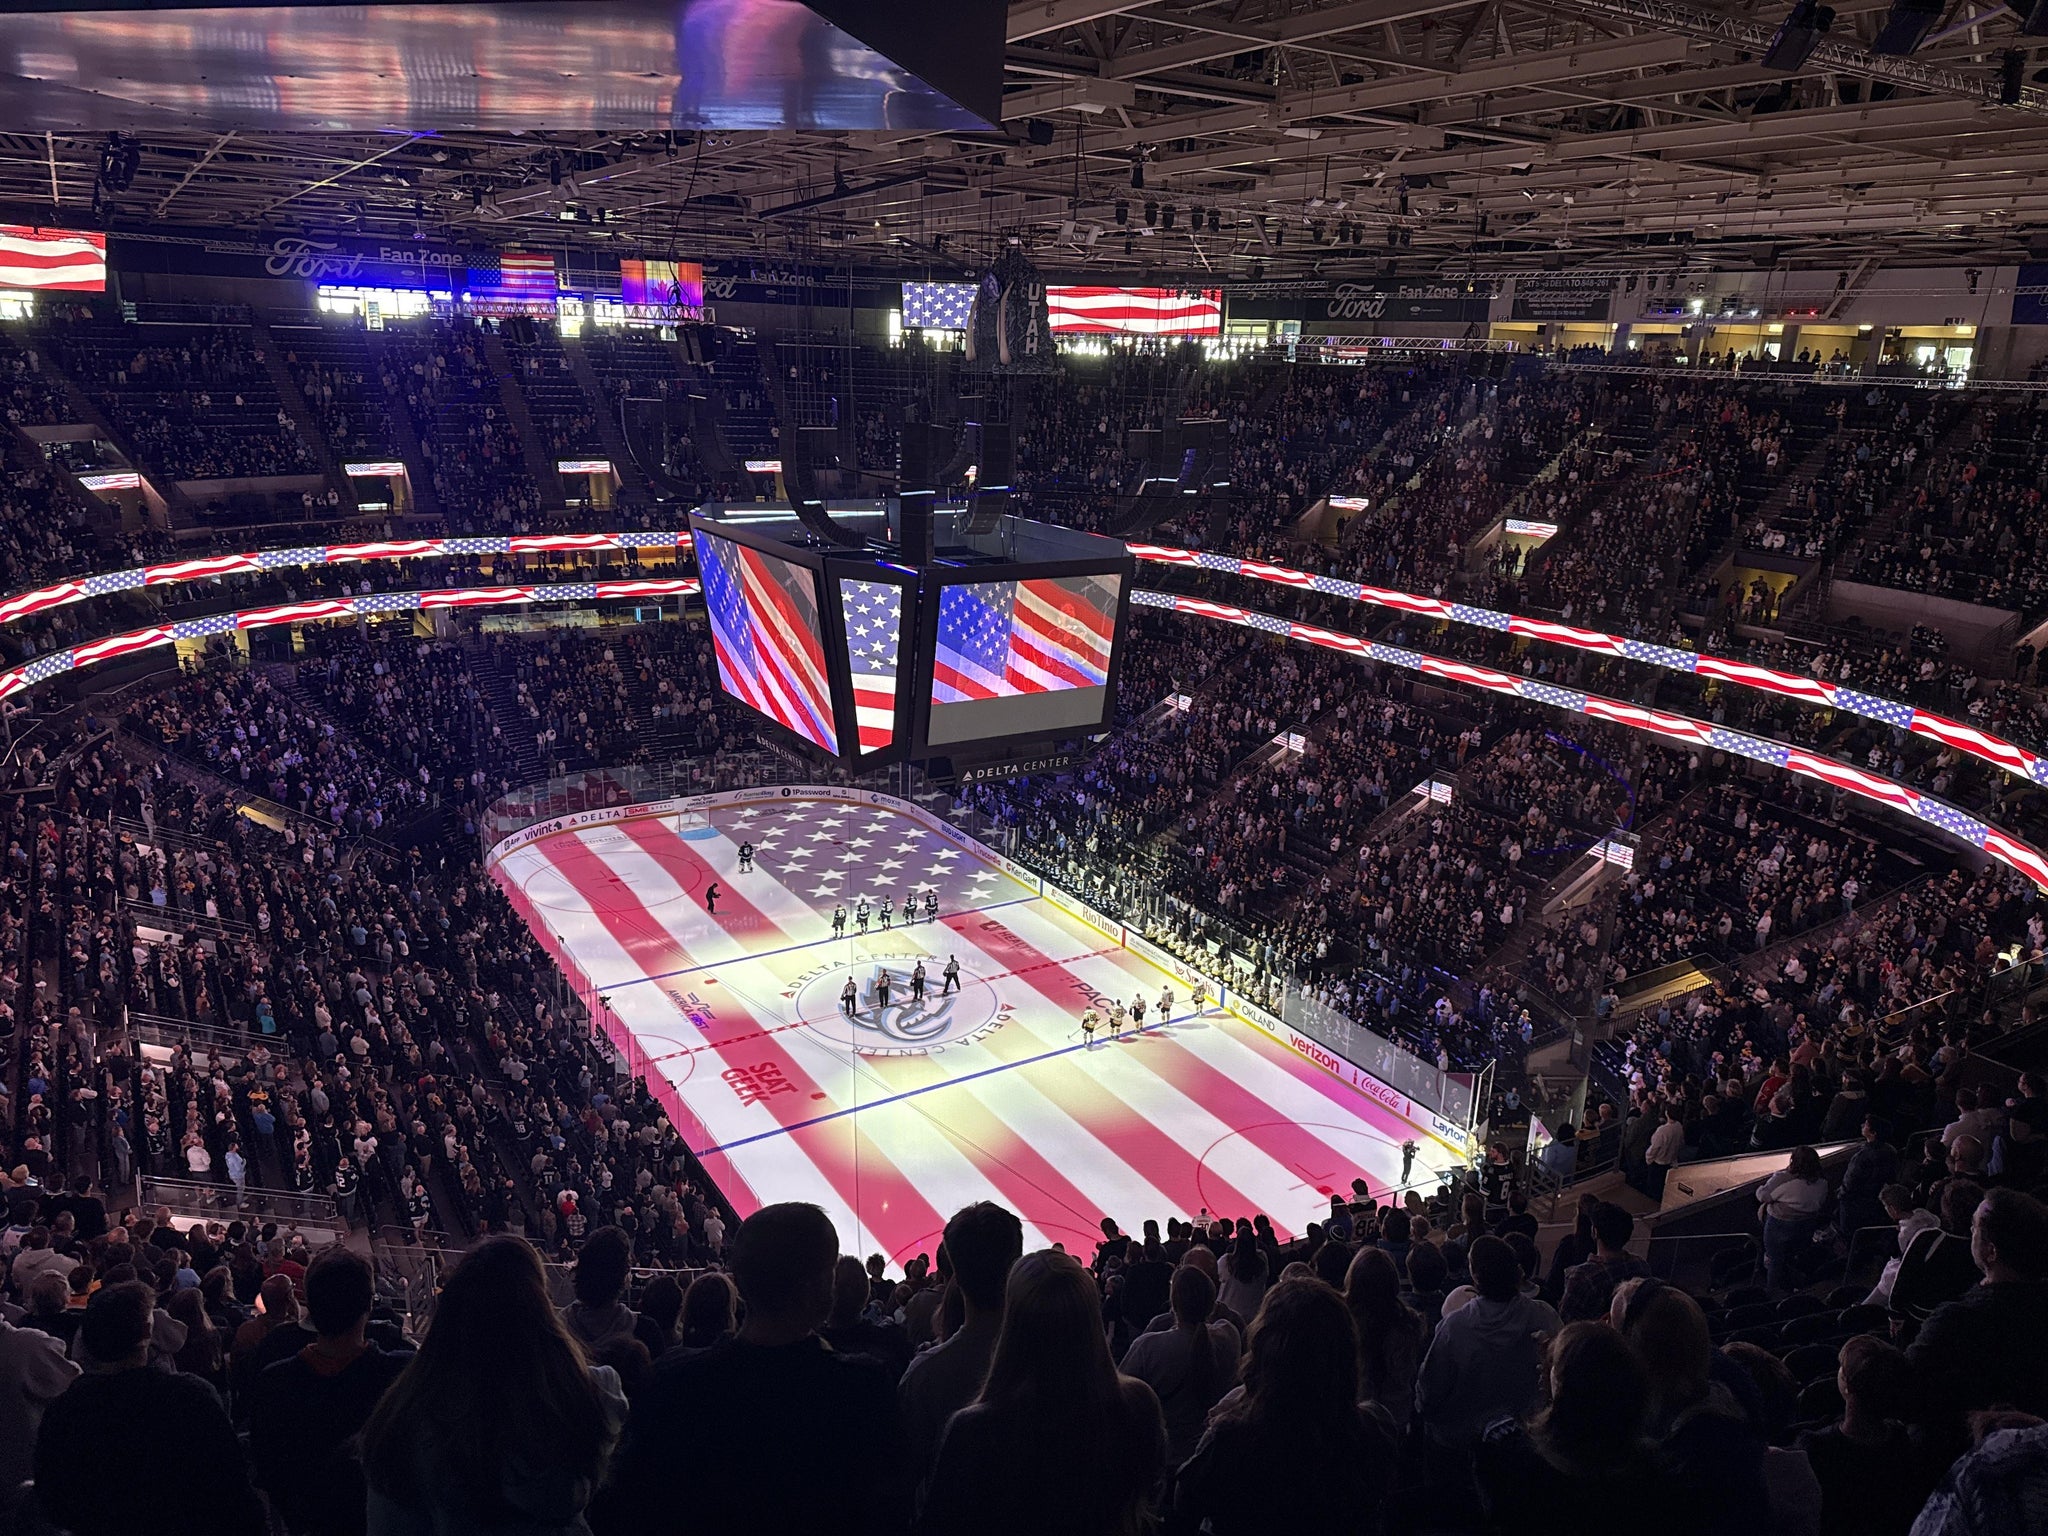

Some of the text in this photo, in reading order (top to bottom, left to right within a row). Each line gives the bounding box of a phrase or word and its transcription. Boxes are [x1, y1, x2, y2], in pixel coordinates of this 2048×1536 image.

[265, 237, 365, 278] Ford
[379, 247, 463, 266] Fan Zone
[1327, 283, 1387, 319] Ford
[1399, 285, 1458, 299] Fan Zone
[1025, 282, 1041, 354] UTAH
[976, 757, 1069, 779] DELTA CENTER
[792, 788, 831, 796] 1Password
[581, 810, 621, 823] DELTA
[941, 824, 966, 844] BUD LIGHT
[1011, 867, 1037, 888] Ken Garff
[788, 952, 939, 990] DELTA CENTER
[667, 989, 695, 1015] AMERICA
[688, 1013, 710, 1030] FIRST
[1241, 1005, 1276, 1032] OKLAND
[851, 1013, 1012, 1057] DELTA CENTER
[1289, 1033, 1340, 1074] verizon
[721, 1068, 771, 1107] GEEK
[749, 1062, 799, 1095] SEAT
[1432, 1116, 1467, 1146] Layton
[1501, 1181, 1511, 1201] 8
